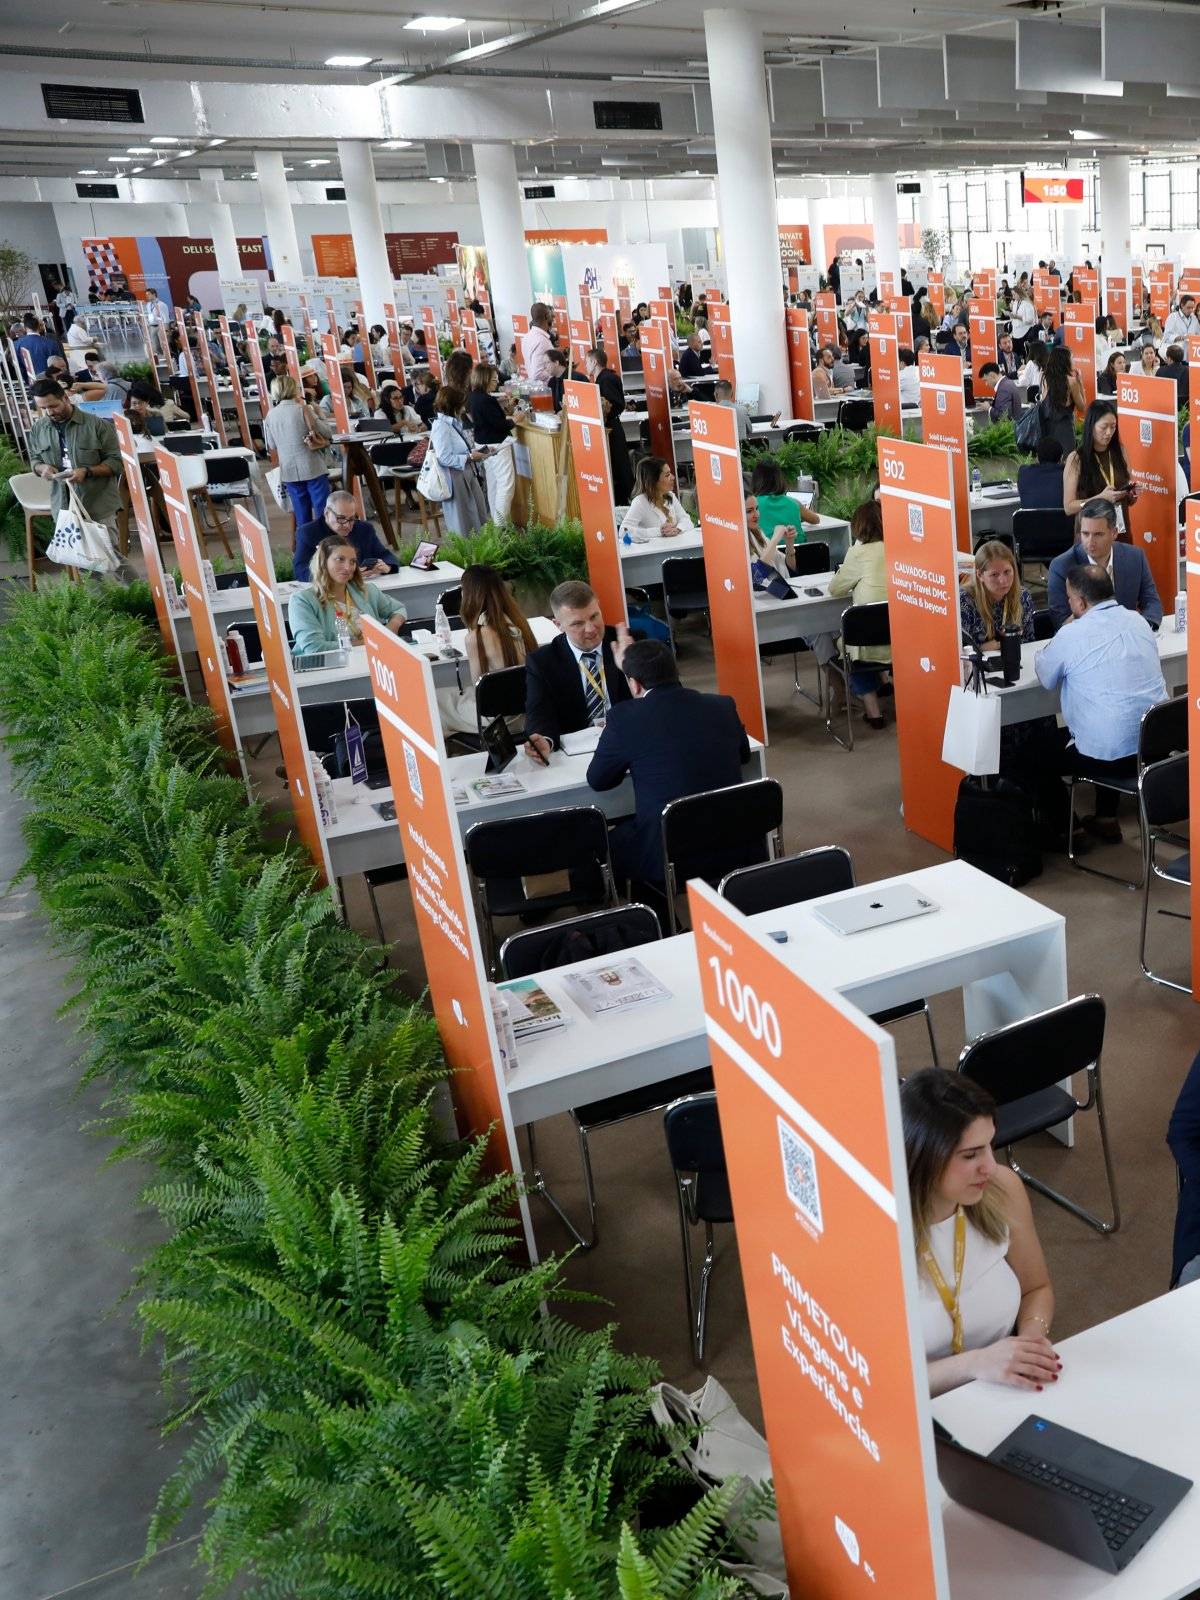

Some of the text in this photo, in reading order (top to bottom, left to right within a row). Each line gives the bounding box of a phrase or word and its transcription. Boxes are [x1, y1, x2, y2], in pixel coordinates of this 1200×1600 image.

[183, 246, 203, 254] DELI
[242, 244, 262, 252] EAST
[922, 366, 935, 378] 804
[1121, 388, 1138, 403] 803
[693, 420, 708, 436] 903
[884, 458, 906, 480] 902
[724, 518, 738, 532] London
[894, 560, 945, 585] CALVADOS CLUB
[892, 574, 912, 592] Luxury
[912, 580, 932, 596] Travel
[932, 586, 948, 601] DMC
[896, 590, 948, 616] Croatia & beyond
[372, 656, 399, 702] 1001
[708, 956, 782, 1058] 1000
[771, 1252, 871, 1386] PRIMETOUR
[786, 1300, 864, 1410] Viagens e
[781, 1325, 881, 1463] Experiências
